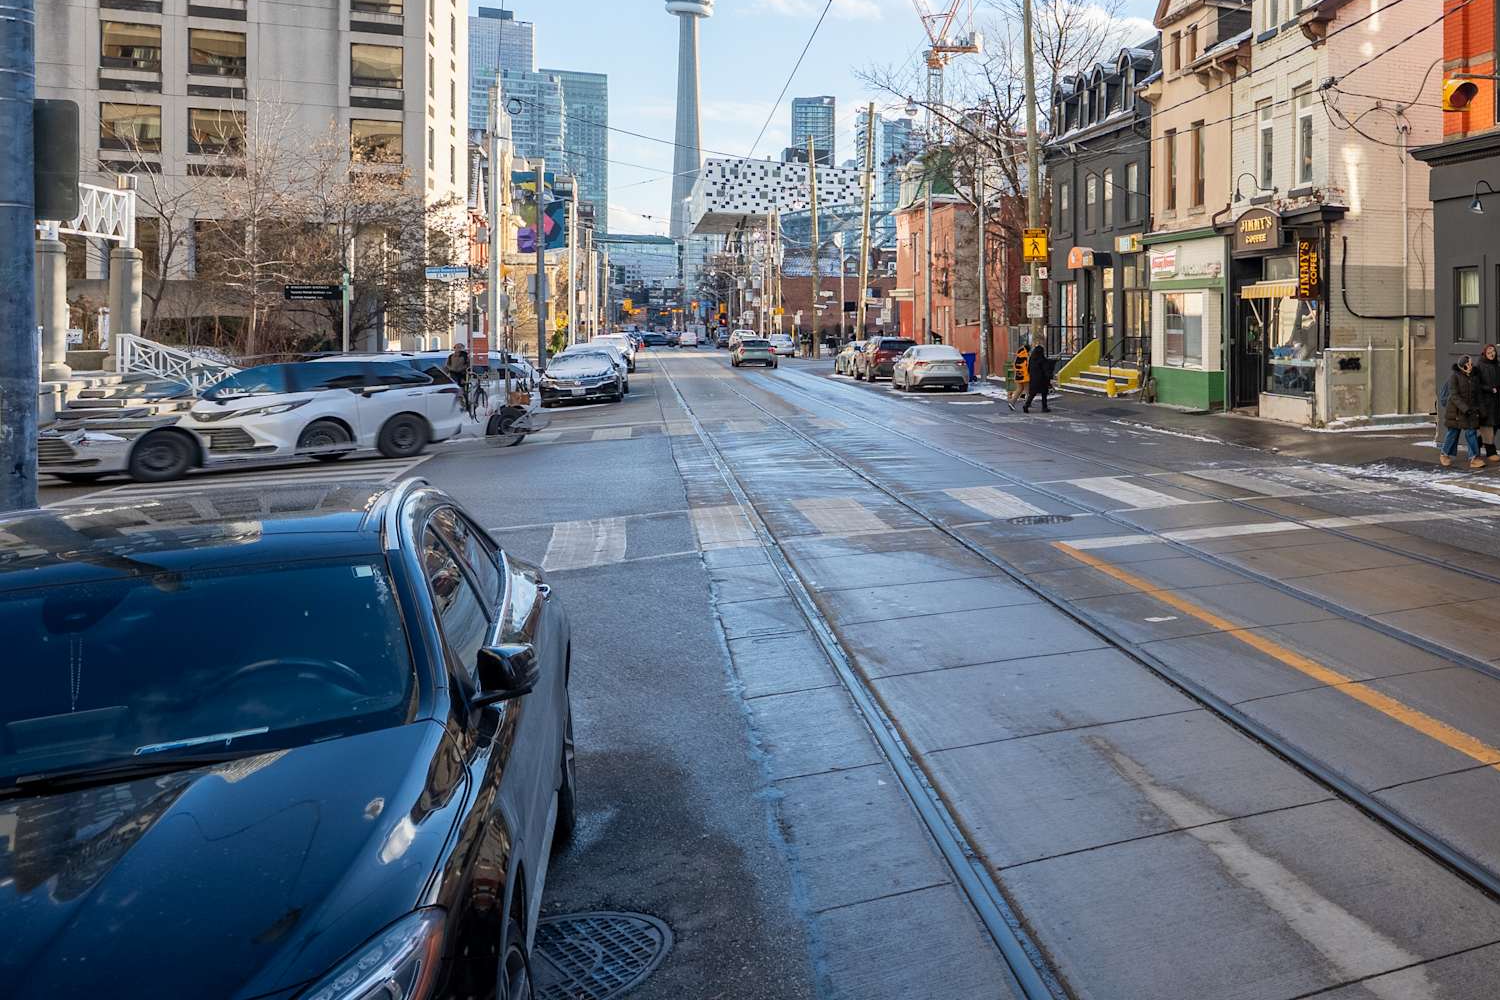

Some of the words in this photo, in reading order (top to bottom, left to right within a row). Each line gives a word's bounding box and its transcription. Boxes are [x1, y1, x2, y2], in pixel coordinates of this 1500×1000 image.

[1240, 216, 1272, 232] JIMMY'S
[1245, 233, 1267, 244] COFFEE
[1300, 241, 1310, 297] JIMMY'S
[1310, 252, 1318, 286] COFFEE
